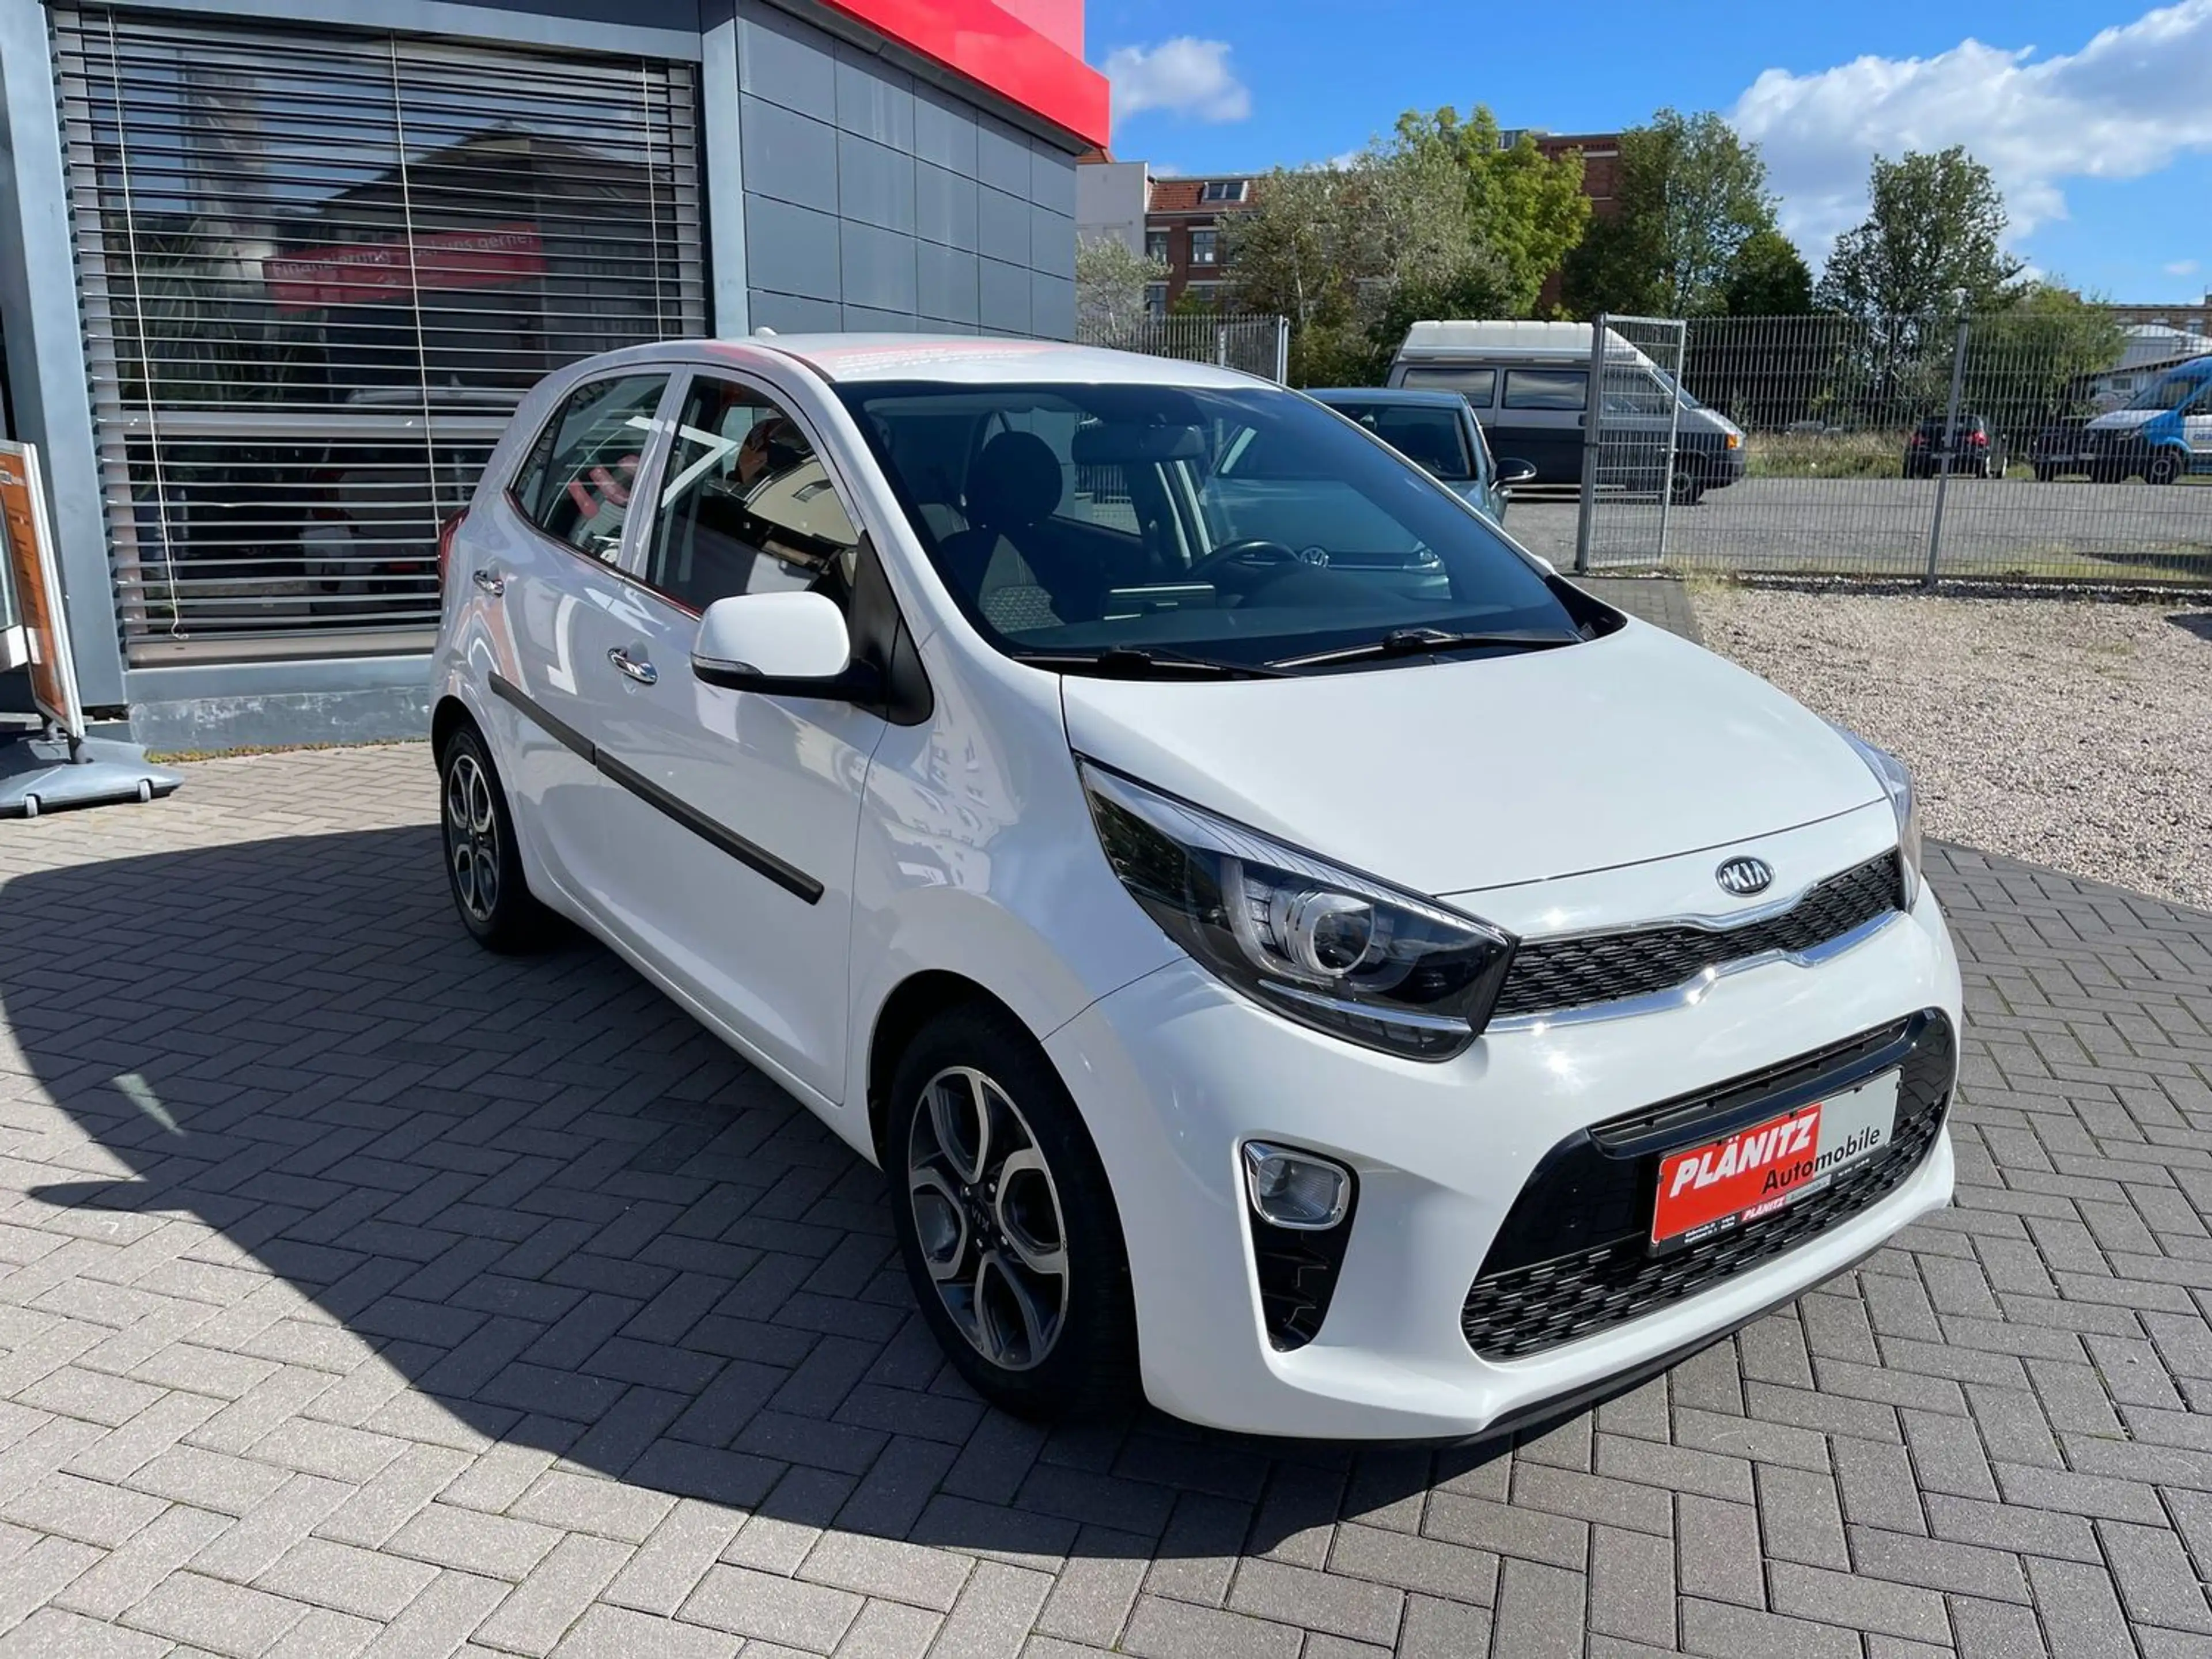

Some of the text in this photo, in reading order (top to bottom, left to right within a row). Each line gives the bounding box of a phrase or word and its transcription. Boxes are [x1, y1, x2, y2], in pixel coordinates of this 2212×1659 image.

[1724, 861, 1770, 890] KIA
[1669, 1112, 1817, 1198] PLÄNITZ
[1762, 1126, 1880, 1194] Automobile
